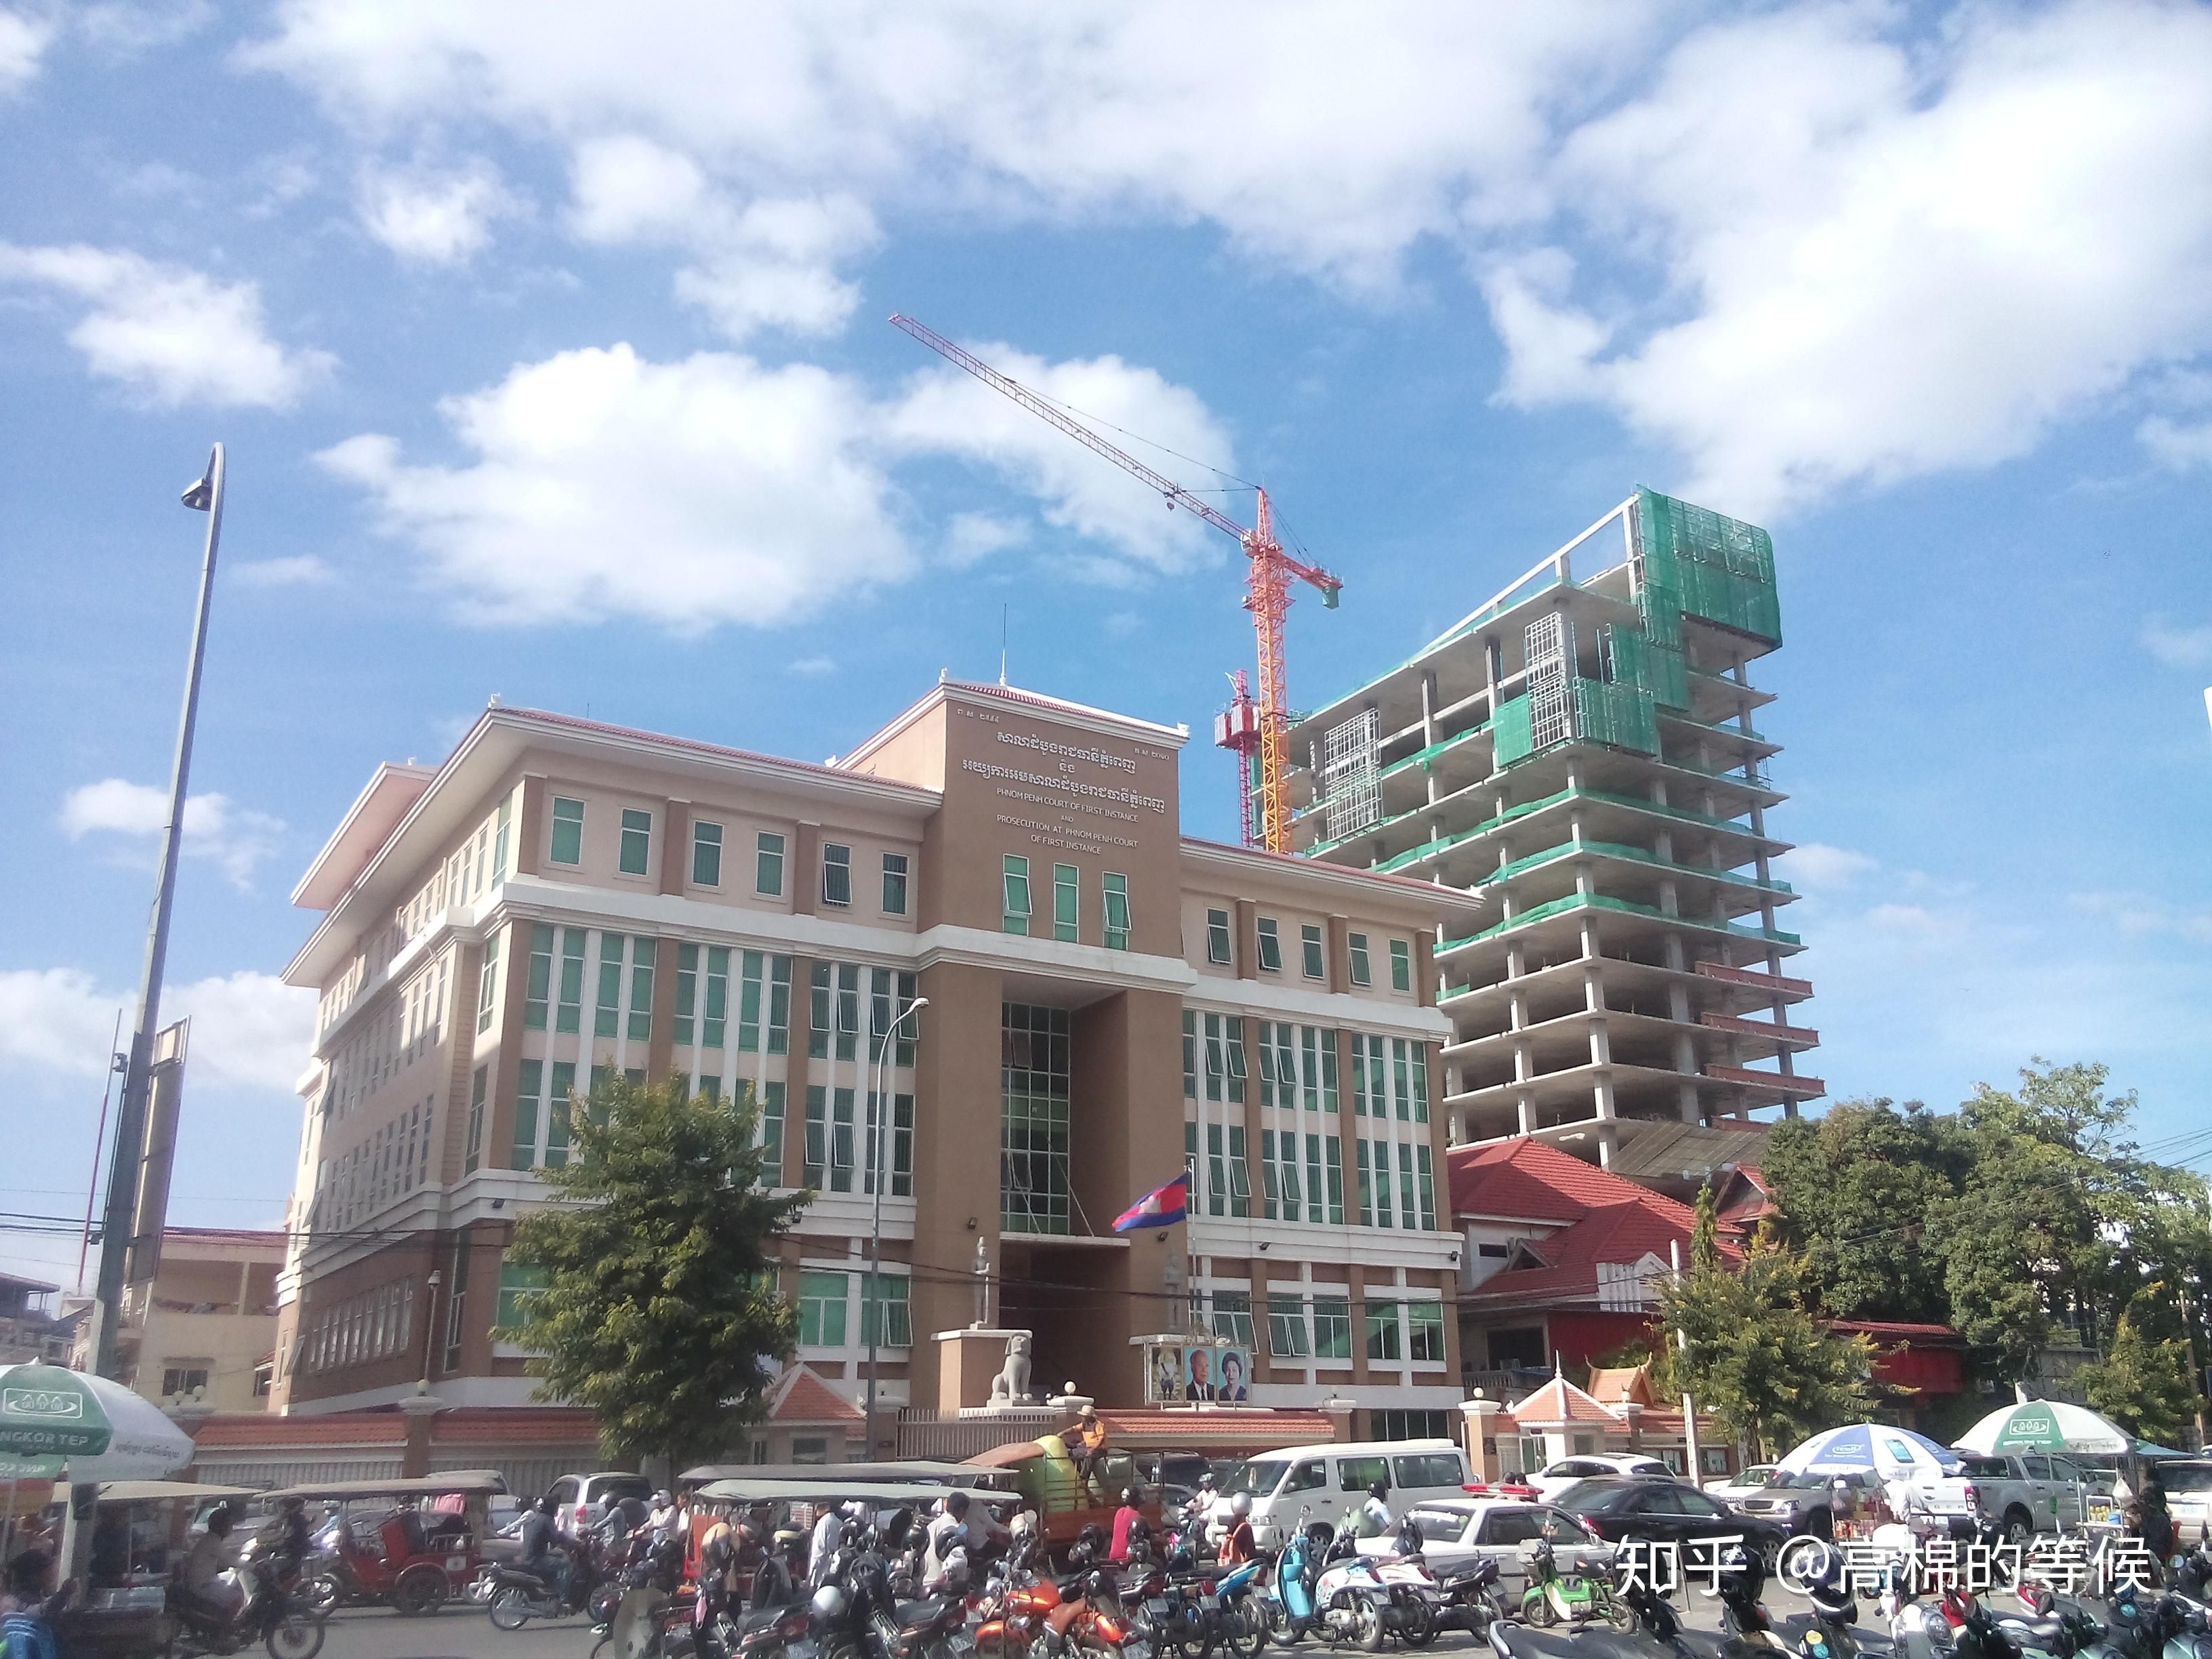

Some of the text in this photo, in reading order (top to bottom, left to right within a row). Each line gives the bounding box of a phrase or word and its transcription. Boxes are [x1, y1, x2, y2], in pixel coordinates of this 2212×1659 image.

[997, 787, 1139, 822] PHNOM PENH COURT OF FIRST INSTANCE
[997, 815, 1139, 848] PROSECUTION AT PHNOM PENH COURT
[1031, 834, 1101, 855] OF FIRST INSTANCE
[0, 1431, 55, 1443] NGKOR
